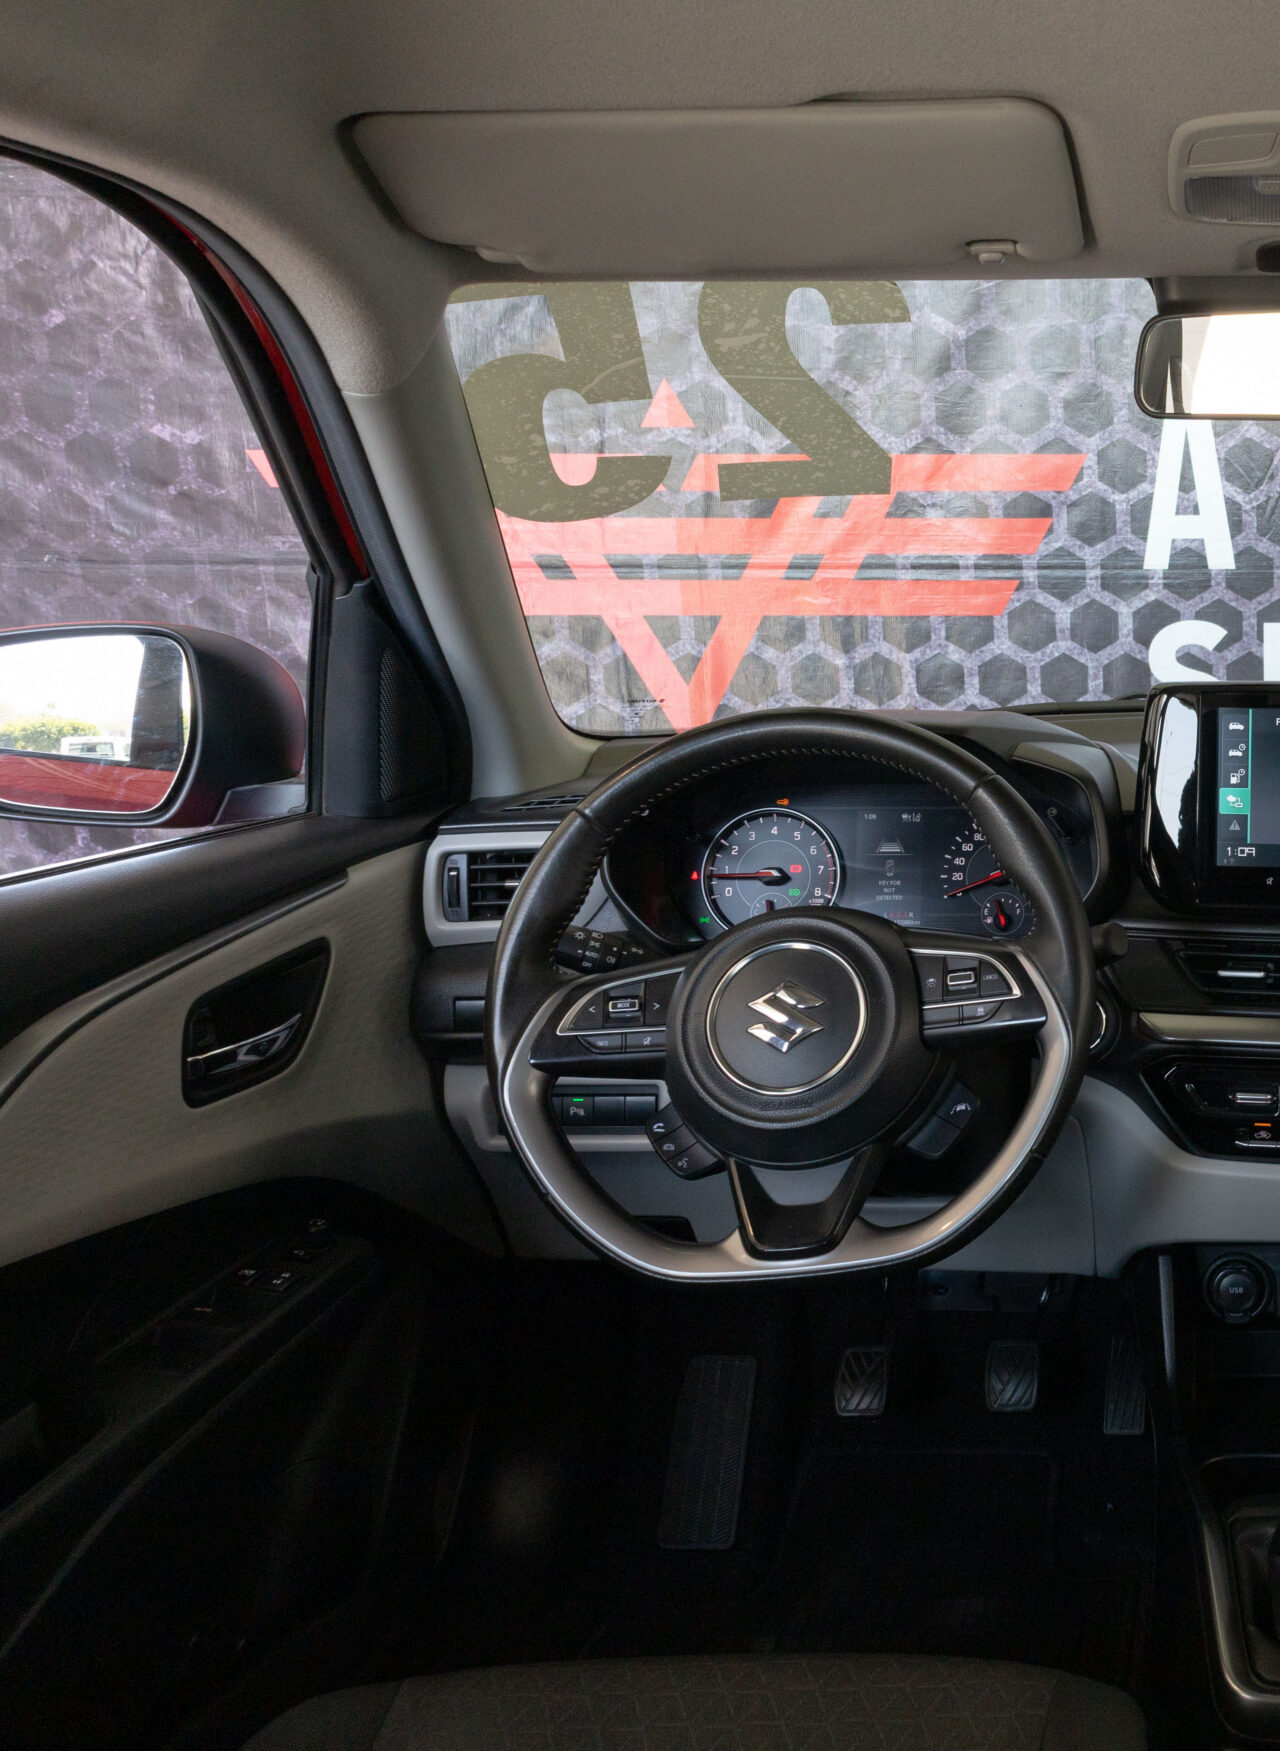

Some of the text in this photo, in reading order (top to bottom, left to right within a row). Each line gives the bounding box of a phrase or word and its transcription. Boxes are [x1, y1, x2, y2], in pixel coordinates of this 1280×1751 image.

[748, 831, 756, 840] 3
[770, 826, 778, 836] 4
[793, 831, 801, 840] 5
[731, 845, 739, 855] 2
[810, 845, 817, 855] 6
[962, 843, 974, 851] 60
[1226, 846, 1256, 857] 1:09
[953, 857, 965, 865] 40
[818, 865, 824, 875] 7
[952, 872, 964, 880] 20
[725, 887, 733, 897] 0
[814, 887, 822, 896] 8
[584, 950, 598, 958] AUTO
